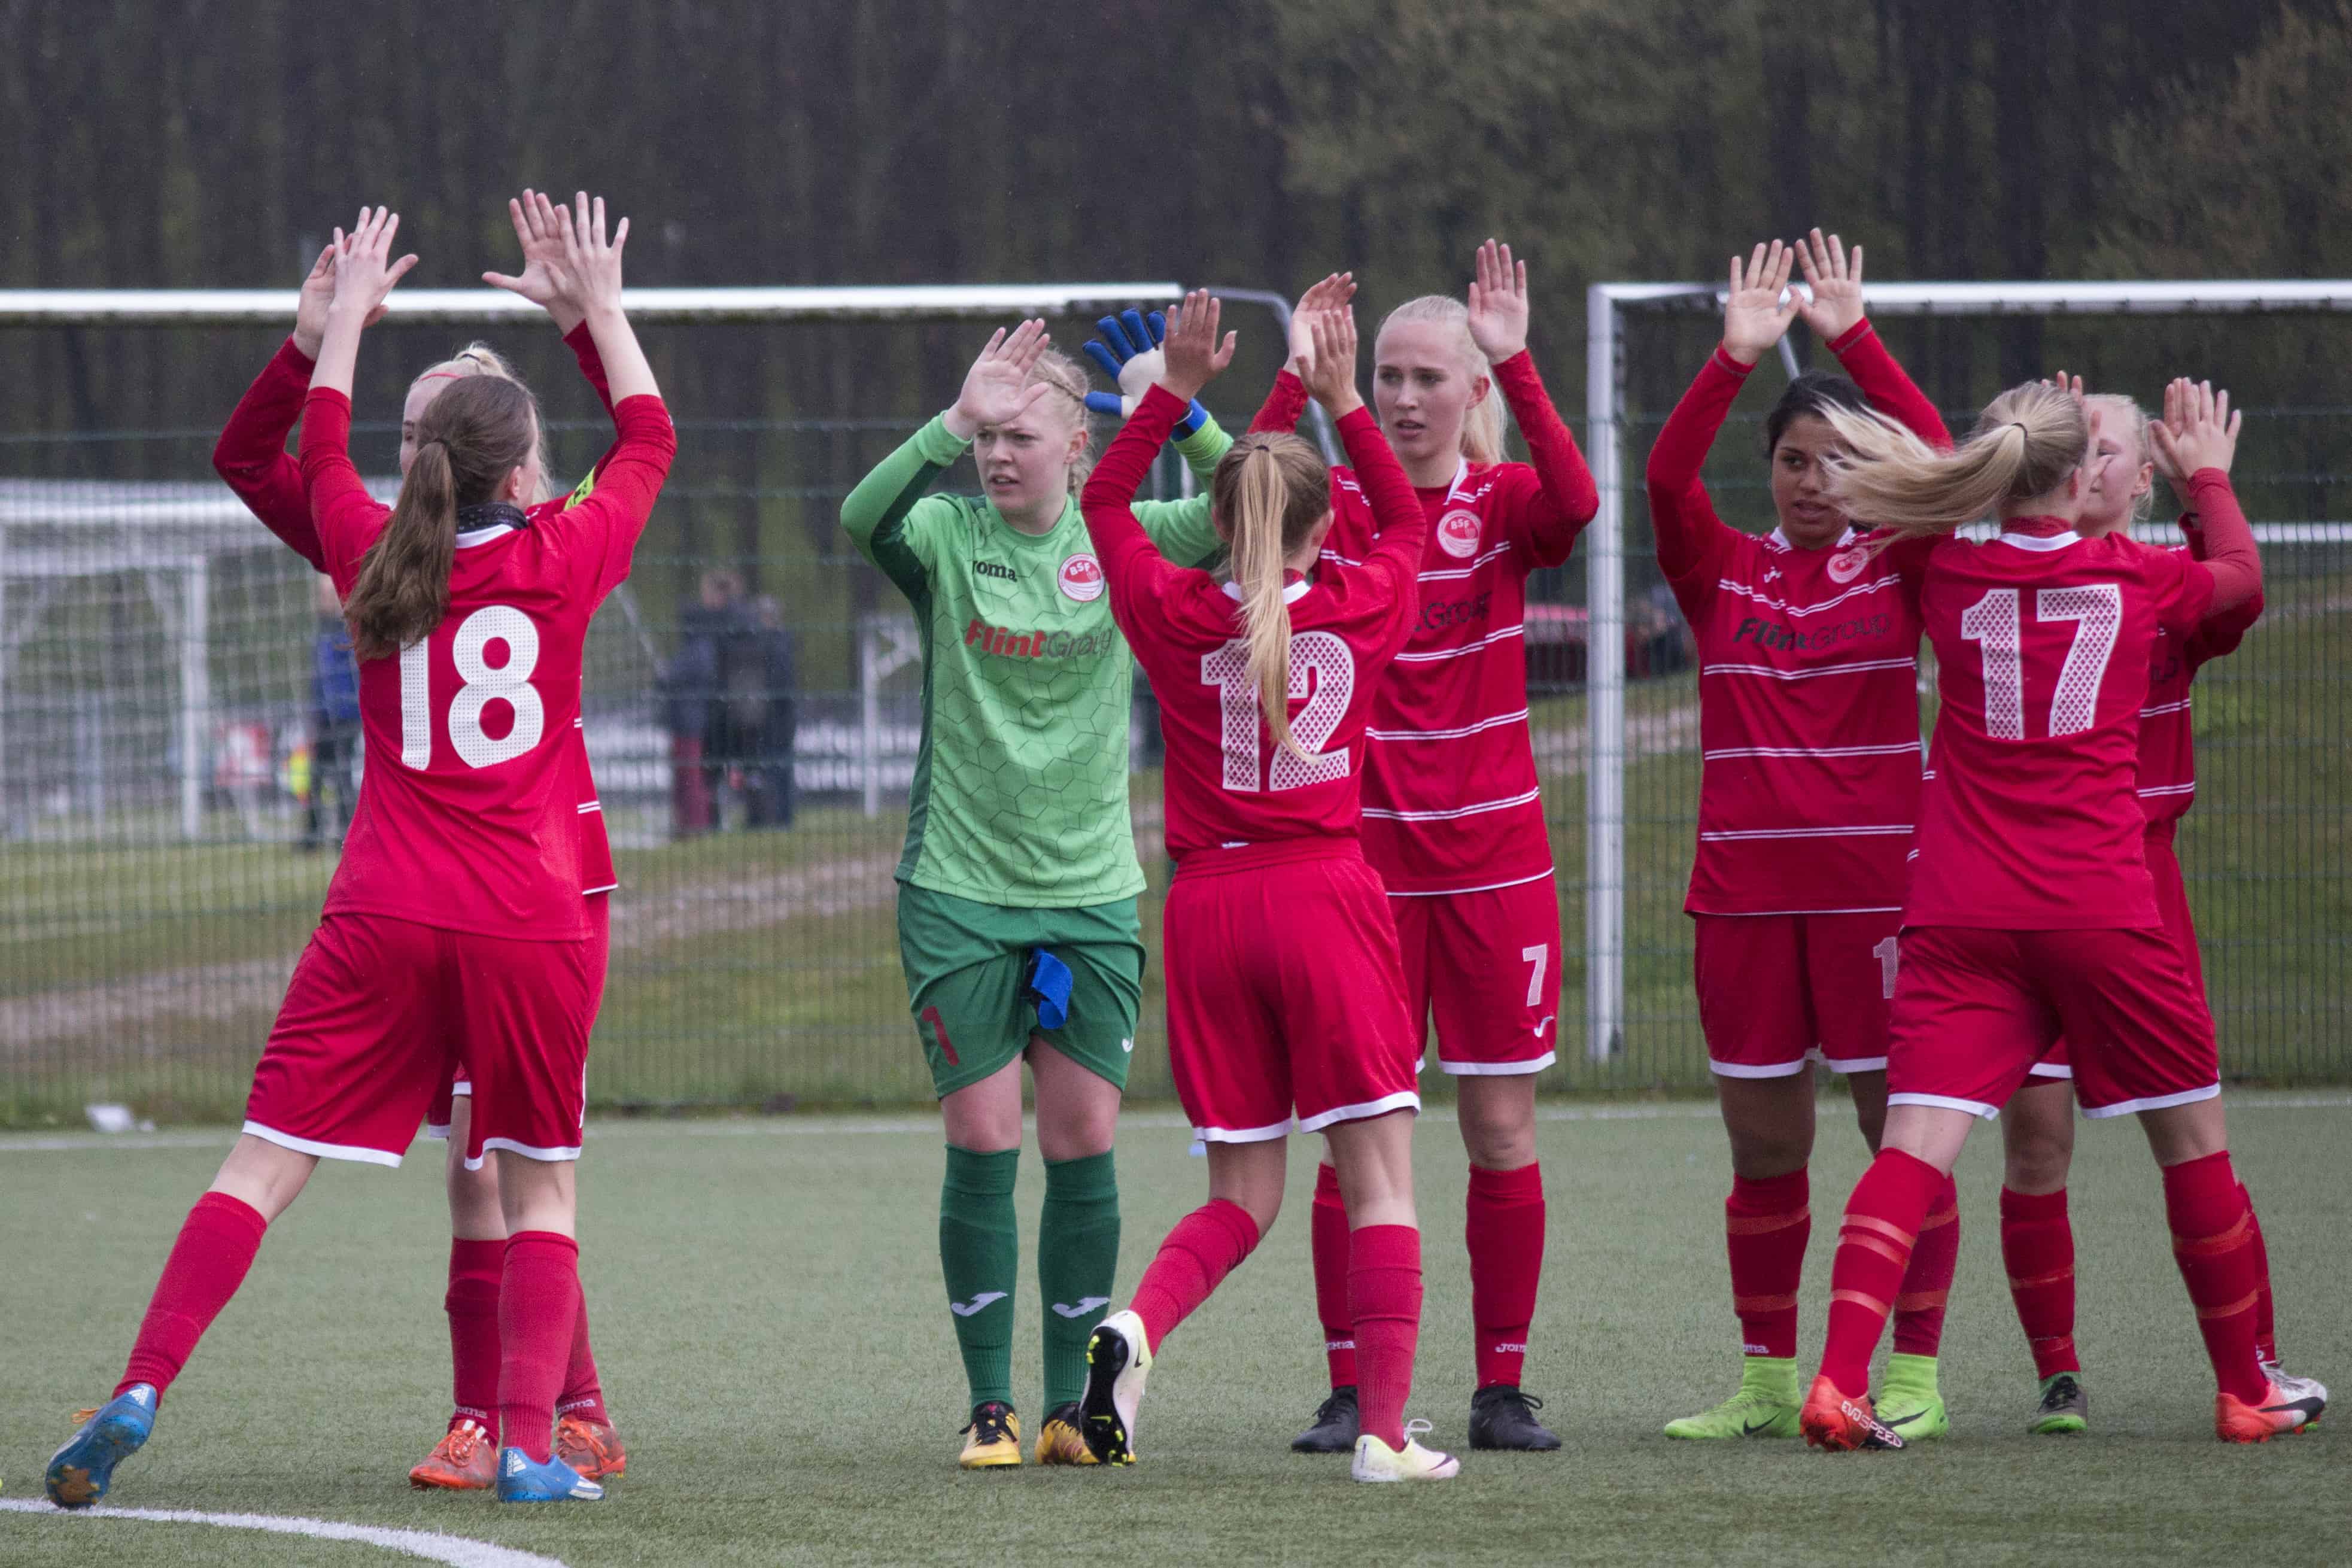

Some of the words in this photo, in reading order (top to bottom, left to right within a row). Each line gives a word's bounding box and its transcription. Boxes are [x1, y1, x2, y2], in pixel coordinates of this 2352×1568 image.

[399, 604, 545, 771] 18
[1201, 630, 1355, 793] 12
[1961, 584, 2123, 741] 17
[1523, 943, 1548, 1007] 7
[1873, 936, 1901, 999] 1
[922, 1006, 959, 1066] 1
